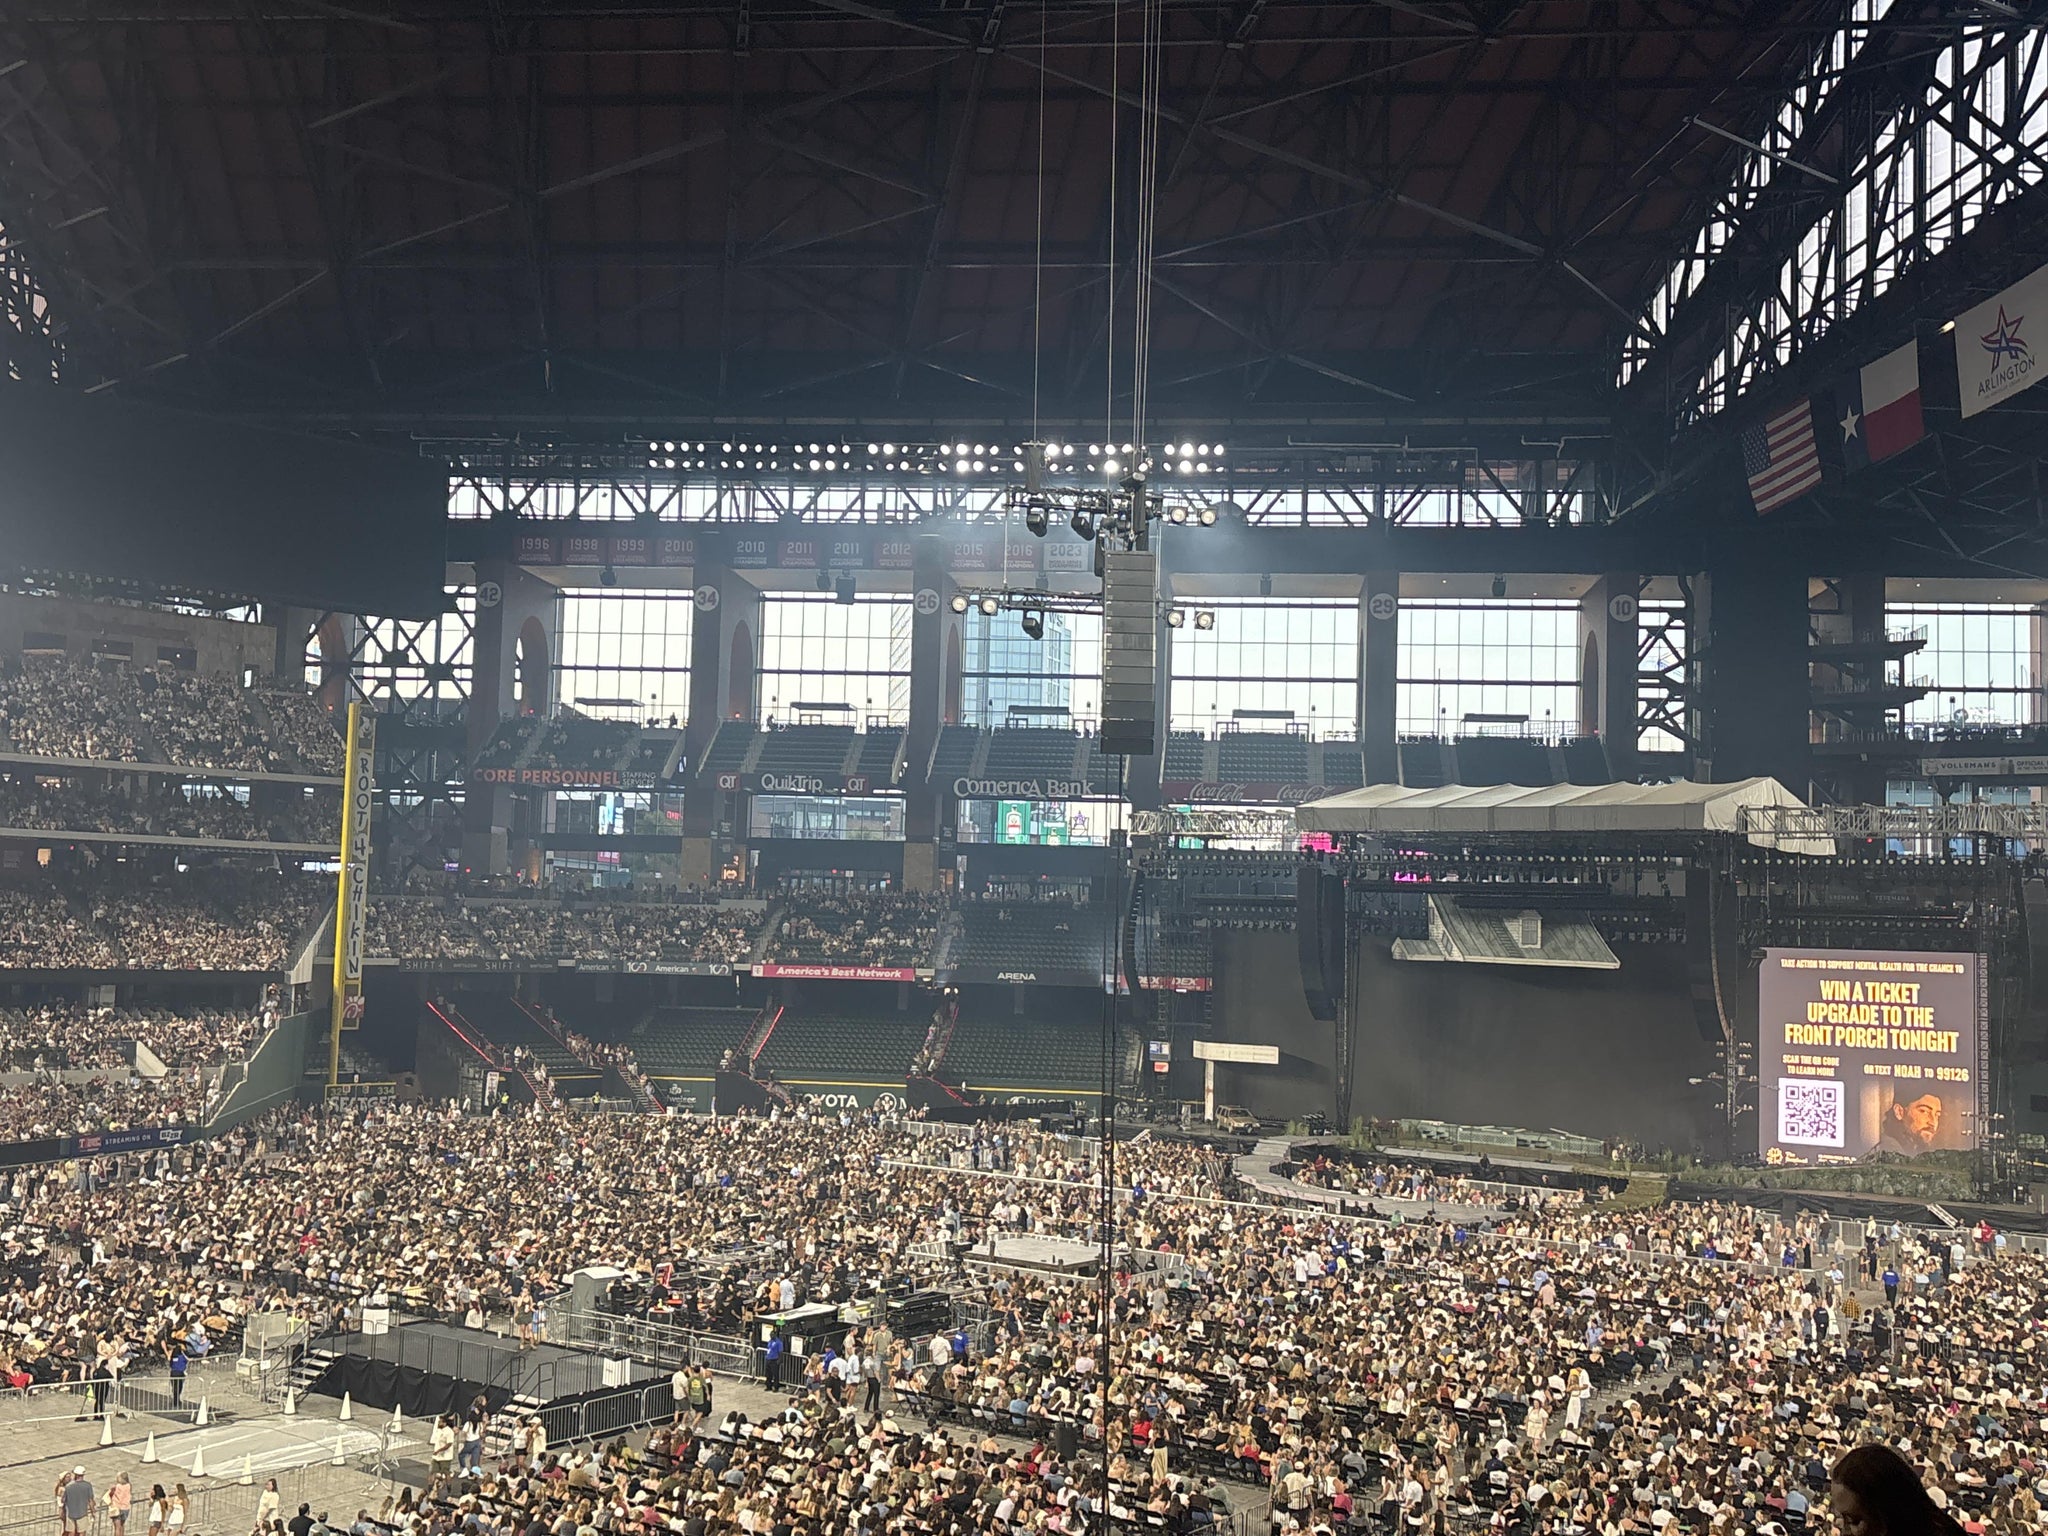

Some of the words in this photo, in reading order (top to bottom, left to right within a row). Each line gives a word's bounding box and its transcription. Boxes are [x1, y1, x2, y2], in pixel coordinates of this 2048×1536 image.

[1978, 355, 2035, 396] ARLINGTON
[521, 538, 549, 550] 1996
[570, 538, 598, 551] 1998
[616, 539, 645, 552] 1999
[664, 539, 693, 552] 2010
[736, 540, 765, 553] 2010
[787, 542, 812, 554] 2011
[834, 542, 859, 554] 2011
[882, 543, 911, 556] 2012
[955, 544, 983, 556] 2015
[1005, 544, 1033, 557] 2016
[1050, 544, 1082, 557] 2023
[479, 586, 498, 601] 42
[697, 591, 717, 605] 34
[917, 594, 937, 609] 26
[1372, 598, 1394, 614] 29
[1615, 601, 1632, 615] 10
[473, 769, 516, 783] CORE
[522, 769, 620, 785] PERSONNEL
[622, 771, 656, 779] STAFFING
[719, 775, 736, 789] QT
[761, 773, 823, 793] QuikTrip
[848, 778, 865, 792] QT
[1046, 779, 1095, 796] Bank
[357, 757, 369, 827] ROOT
[354, 838, 367, 856] 4
[406, 961, 435, 970] SHIFT
[485, 961, 513, 970] SHIFT
[578, 963, 609, 971] American
[655, 964, 689, 973] American
[776, 966, 829, 976] America's
[831, 967, 854, 977] Best
[856, 968, 901, 978] Network
[1796, 959, 1818, 969] ACTION
[1819, 960, 1827, 969] TO
[1827, 960, 1855, 970] SUPPORT
[1855, 961, 1878, 970] MENTAL
[1879, 962, 1901, 971] HEALTH
[1903, 962, 1915, 972] FOR
[1916, 963, 1928, 972] THE
[1929, 963, 1954, 973] CHANCE
[1955, 964, 1964, 974] TO
[997, 972, 1036, 980] ARENA
[1172, 977, 1198, 985] DEX
[1819, 979, 1850, 1001] WIN
[1852, 981, 1865, 1002] A
[1865, 981, 1920, 1004] TICKET
[1807, 1002, 1879, 1026] UPGRADE
[1881, 1005, 1901, 1027] TO
[1904, 1006, 1935, 1028] THE
[1784, 1023, 1833, 1047] FRONT
[1835, 1026, 1888, 1049] PORCH
[1889, 1029, 1960, 1053] TONIGHT
[1782, 1054, 1799, 1064] SCAN
[1800, 1055, 1812, 1065] THE
[1822, 1056, 1840, 1067] CODE
[1787, 1065, 1796, 1074] TO
[1796, 1065, 1816, 1075] LEARN
[1816, 1067, 1835, 1077] MORE
[1863, 1064, 1874, 1075] OR
[1875, 1065, 1892, 1076] TEXT
[1893, 1064, 1922, 1079] NOAH
[1924, 1067, 1934, 1078] TO
[1936, 1066, 1969, 1083] 99126
[377, 1086, 395, 1096] 334
[105, 1136, 140, 1145] STREAMING
